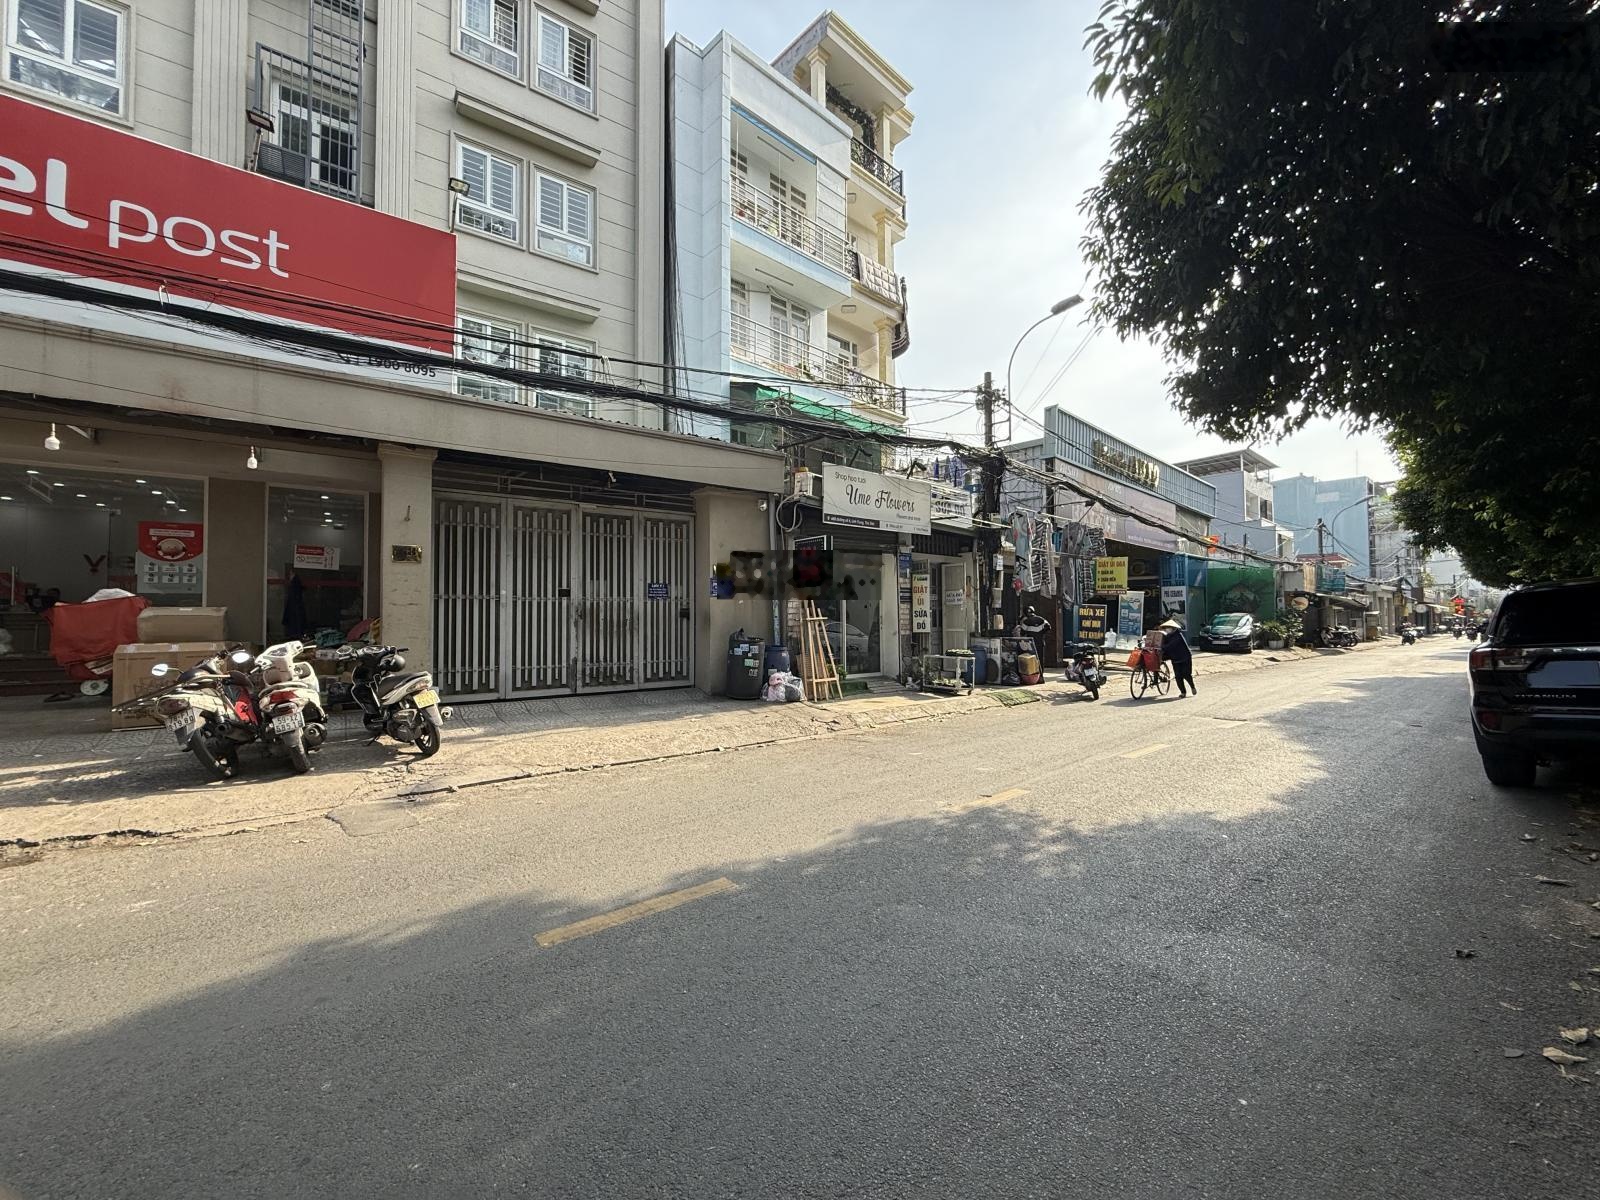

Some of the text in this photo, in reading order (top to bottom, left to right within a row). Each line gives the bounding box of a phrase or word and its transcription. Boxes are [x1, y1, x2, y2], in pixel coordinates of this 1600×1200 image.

[109, 199, 290, 278] post
[845, 484, 915, 512] Ume Flowers
[914, 607, 928, 618] SỬA
[1095, 608, 1105, 617] XE
